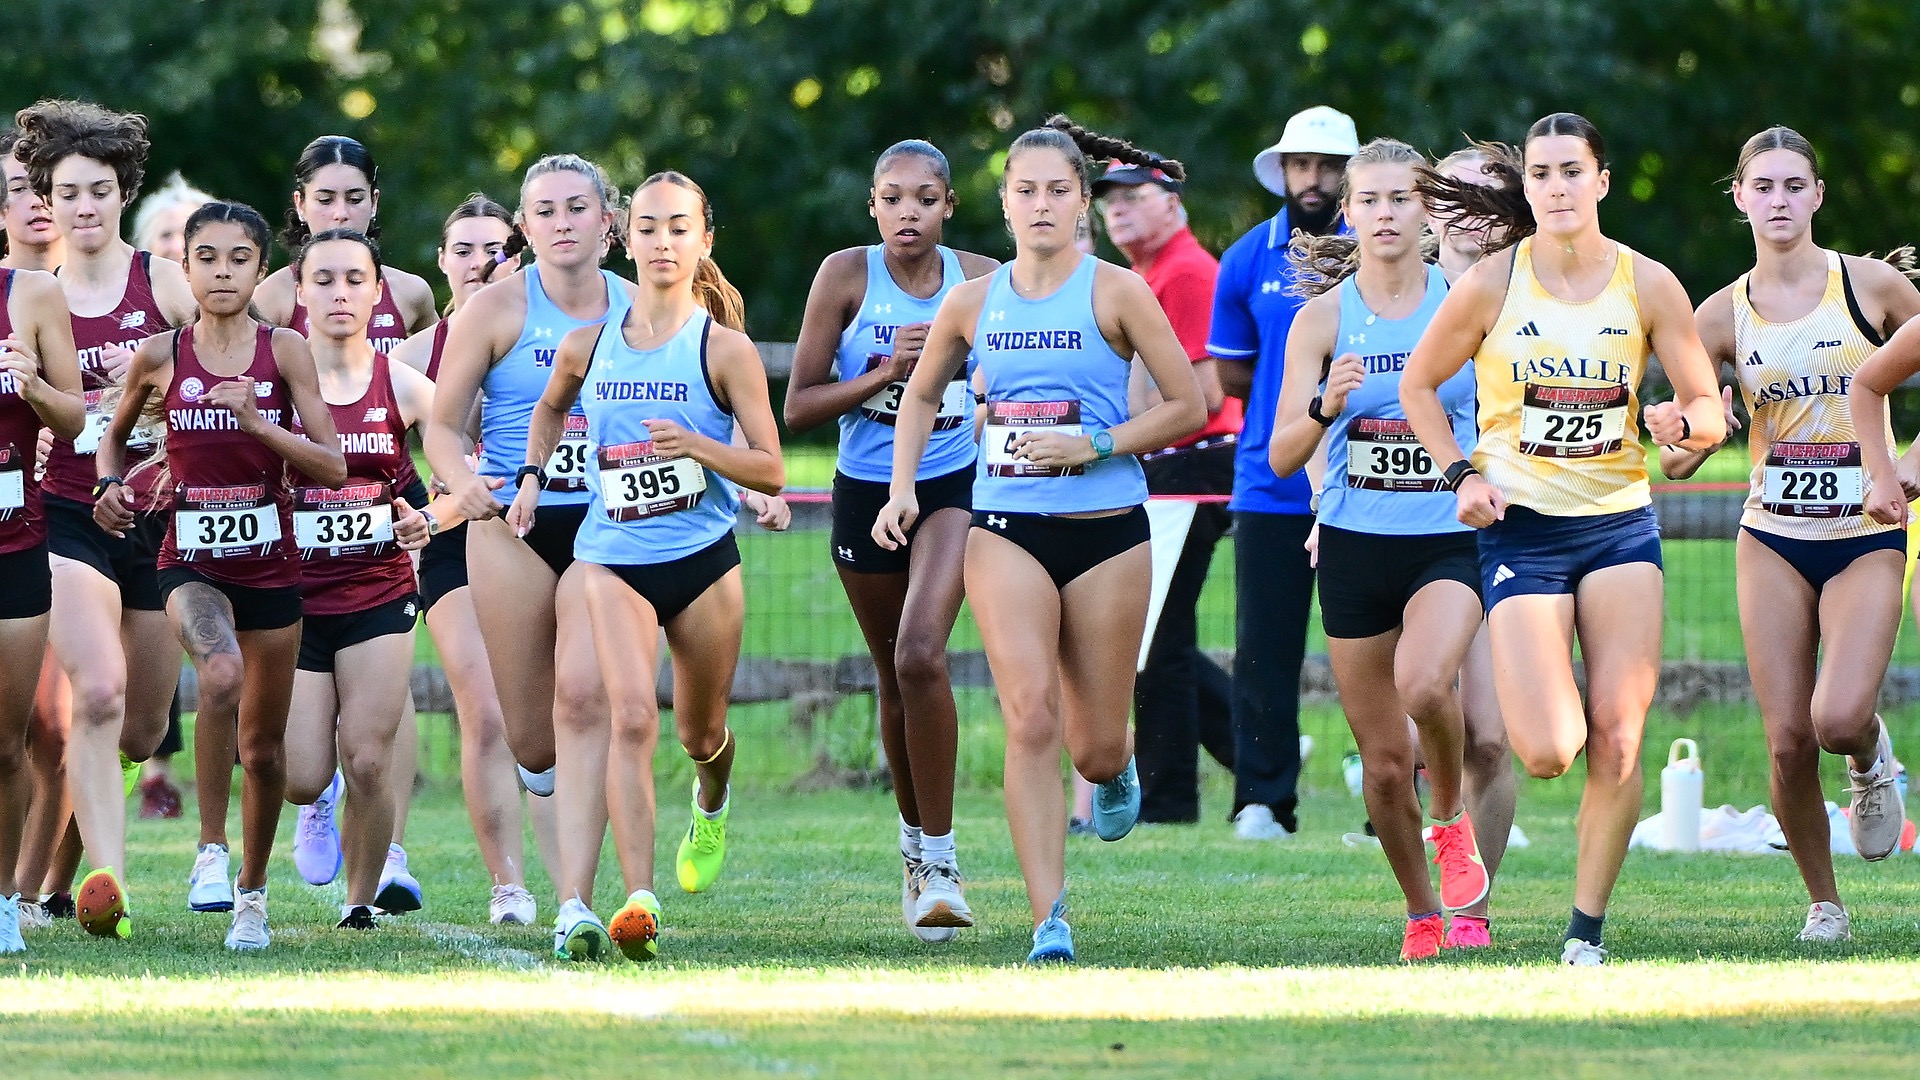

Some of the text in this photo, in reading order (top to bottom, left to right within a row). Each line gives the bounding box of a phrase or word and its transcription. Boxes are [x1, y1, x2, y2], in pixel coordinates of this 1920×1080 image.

[986, 331, 1083, 351] WIDENER
[1510, 357, 1631, 383] LASALLE
[596, 382, 688, 401] WIDENER
[1535, 387, 1620, 402] HAVERFORD
[169, 408, 282, 431] SWARTHRE
[995, 402, 1069, 416] HAVERFORD
[1544, 414, 1603, 442] 225
[555, 444, 587, 474] 39
[1371, 446, 1432, 475] 396
[1773, 444, 1849, 458] HAVERFORD
[186, 484, 265, 502] HAVERFORD
[621, 465, 680, 502] 395
[1781, 471, 1839, 500] 228
[198, 513, 259, 544] 320
[316, 513, 374, 543] 332
